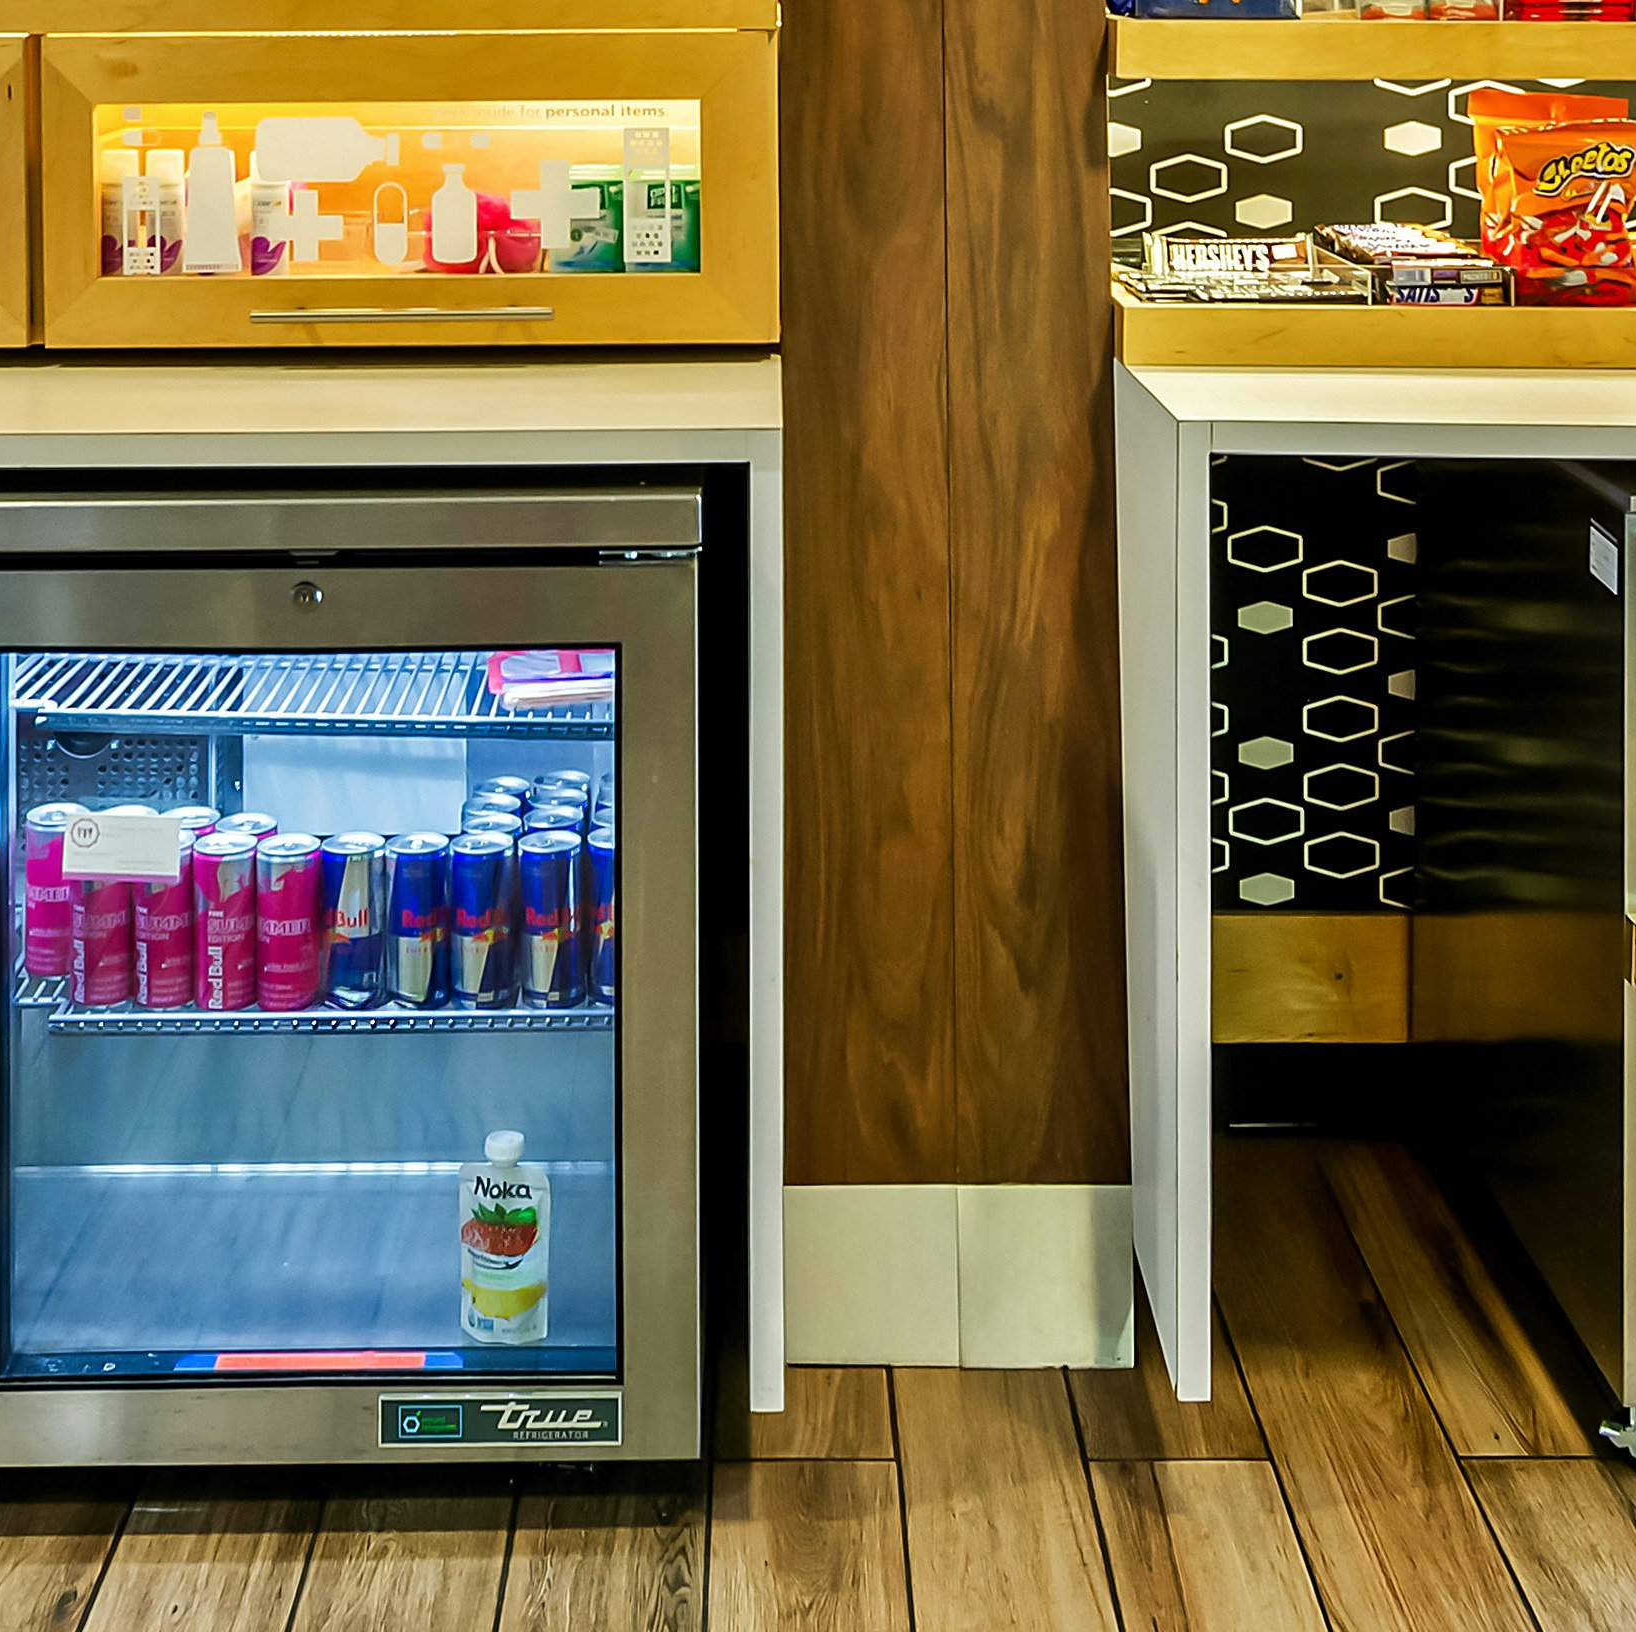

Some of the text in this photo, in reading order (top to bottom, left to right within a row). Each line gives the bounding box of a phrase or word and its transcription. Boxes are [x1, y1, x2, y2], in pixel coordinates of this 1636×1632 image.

[520, 104, 669, 119] for personal items.
[1171, 242, 1271, 272] HERSHEY'S
[473, 1175, 533, 1200] Noka
[512, 1430, 590, 1440] REFRIGERATOR
